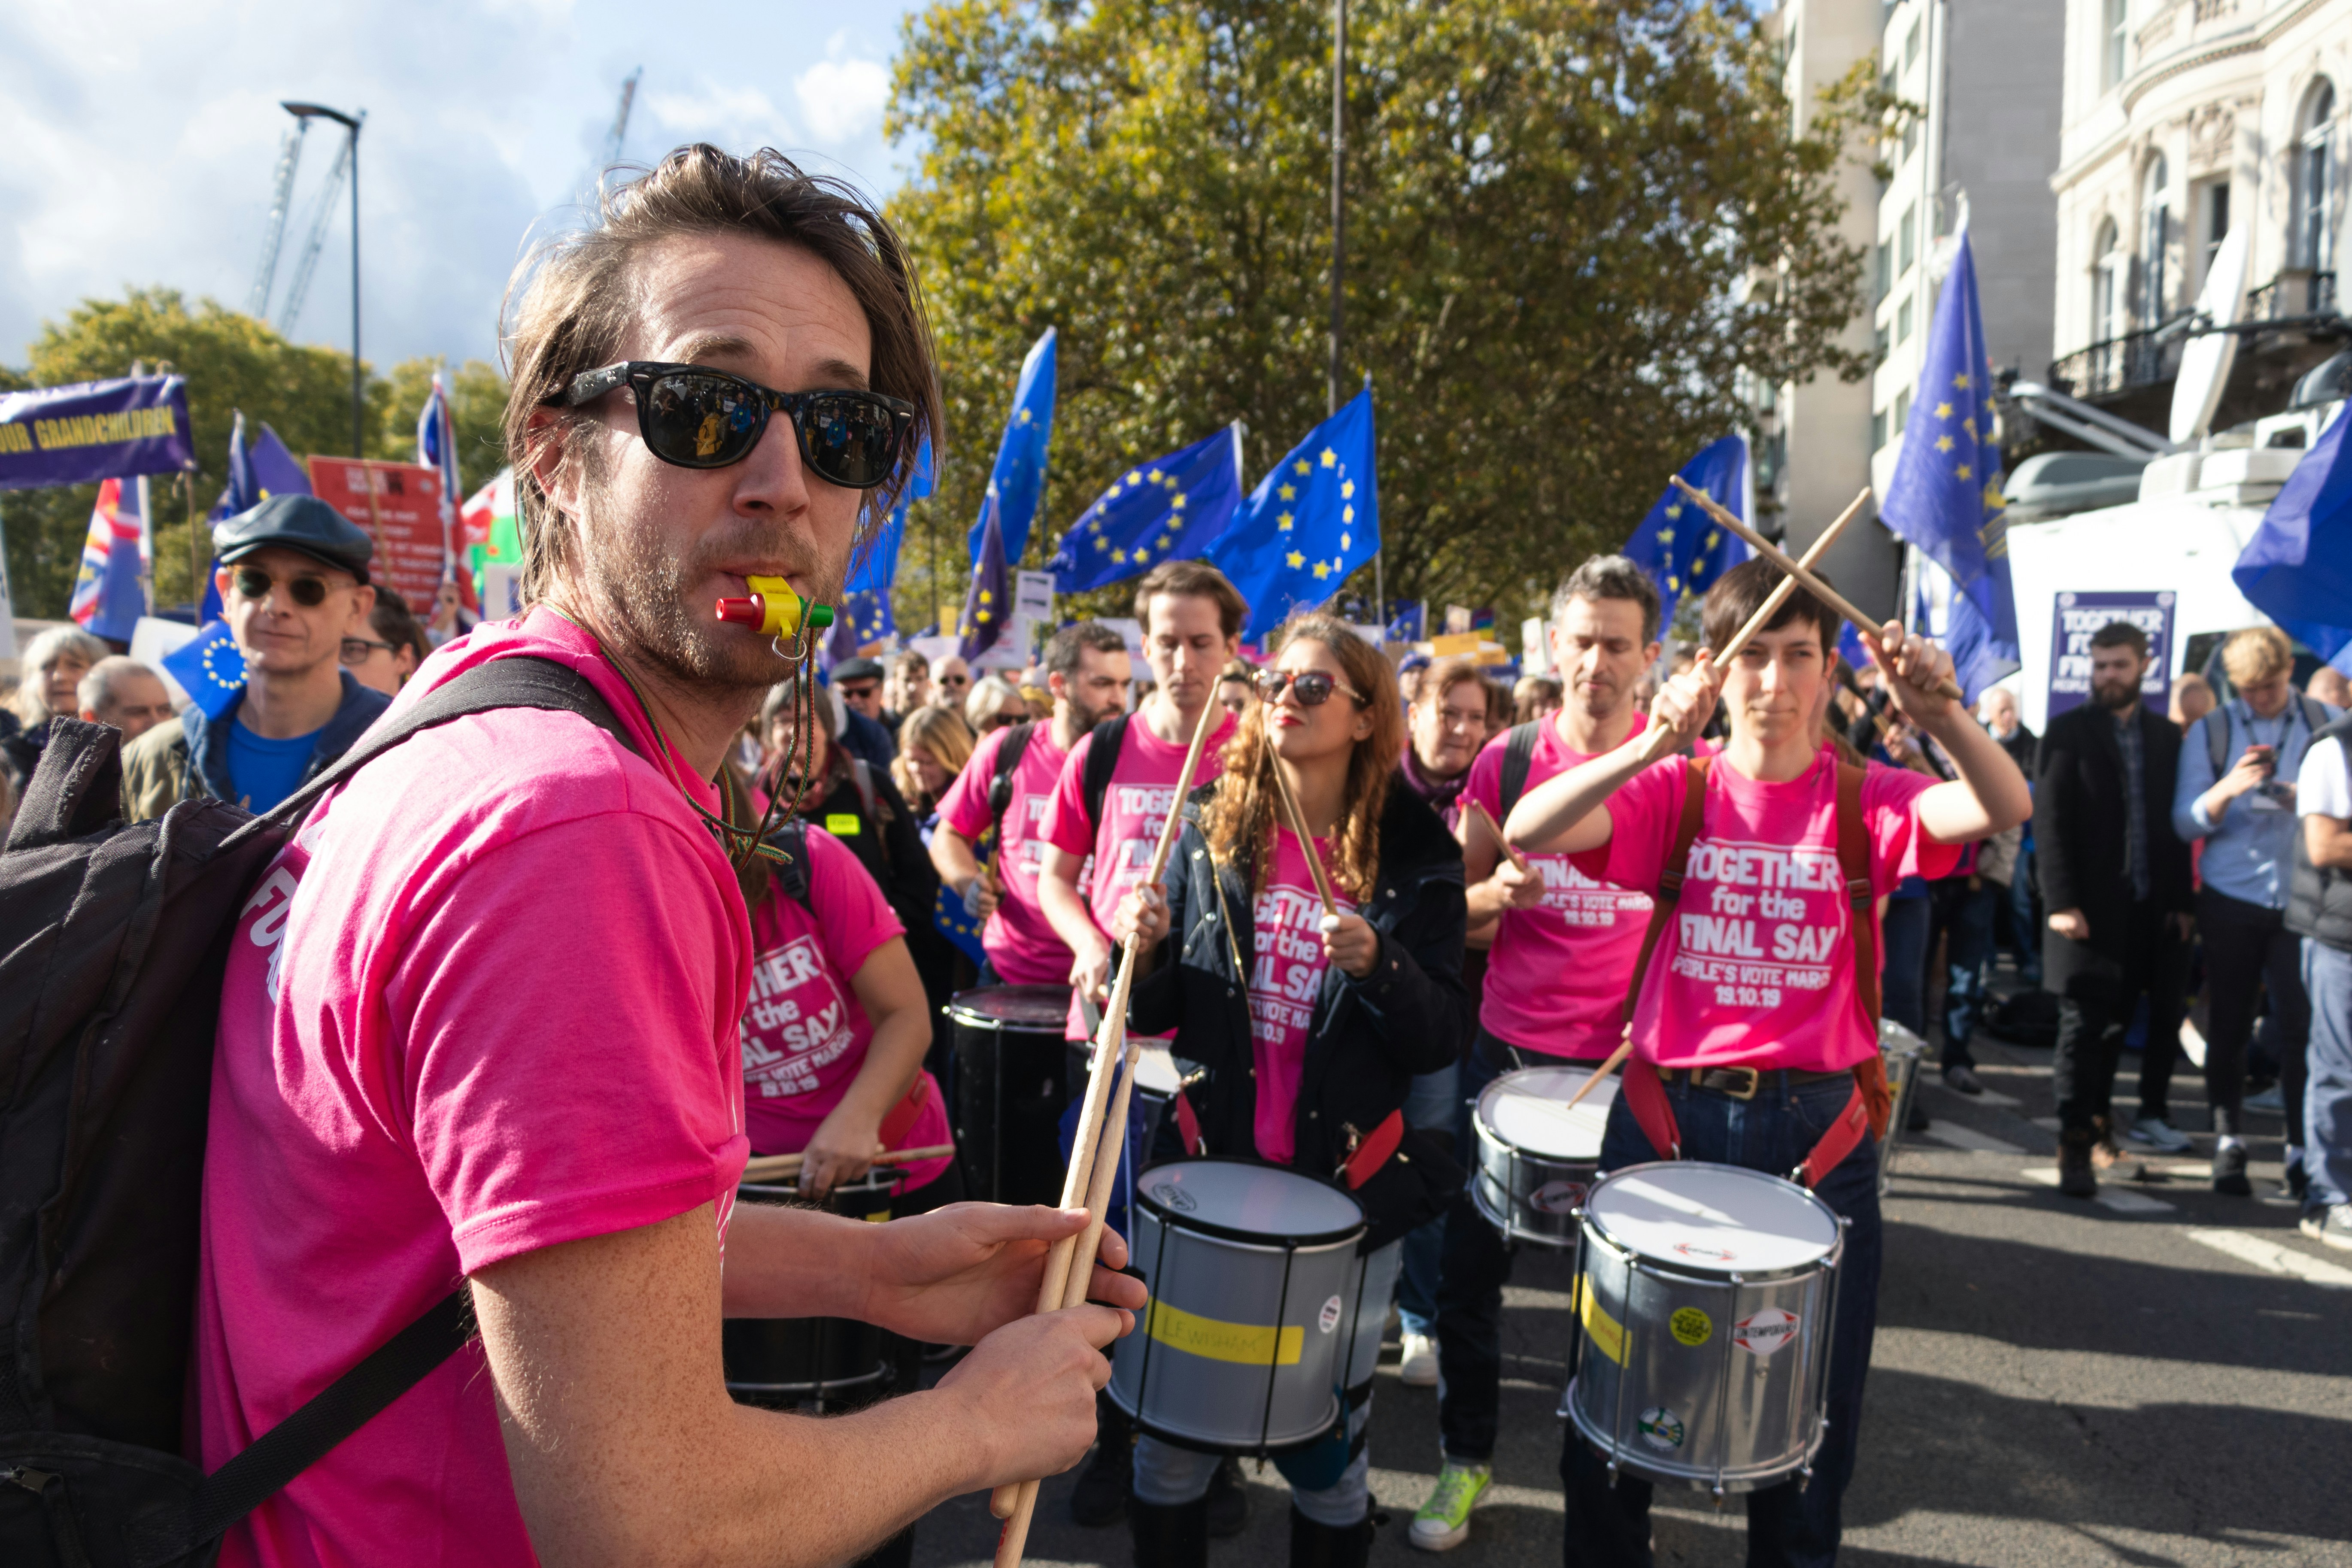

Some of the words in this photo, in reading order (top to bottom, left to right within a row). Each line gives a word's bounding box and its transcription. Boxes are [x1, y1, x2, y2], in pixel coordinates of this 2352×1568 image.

[34, 405, 176, 449] GRANDCHILDREN
[1685, 844, 1840, 892] TOGETHER
[1711, 885, 1755, 916] for
[1758, 889, 1807, 921] the
[1254, 930, 1276, 952] or
[1276, 929, 1319, 964] the
[1679, 913, 1764, 957] FINAL
[1772, 923, 1839, 962] SAY
[1284, 964, 1323, 1003] SA
[1739, 965, 1783, 986] VOTE
[1714, 984, 1781, 1008] 19.10.19
[752, 999, 801, 1030] the
[782, 1000, 839, 1052] SAY
[770, 1057, 813, 1081] VOTE
